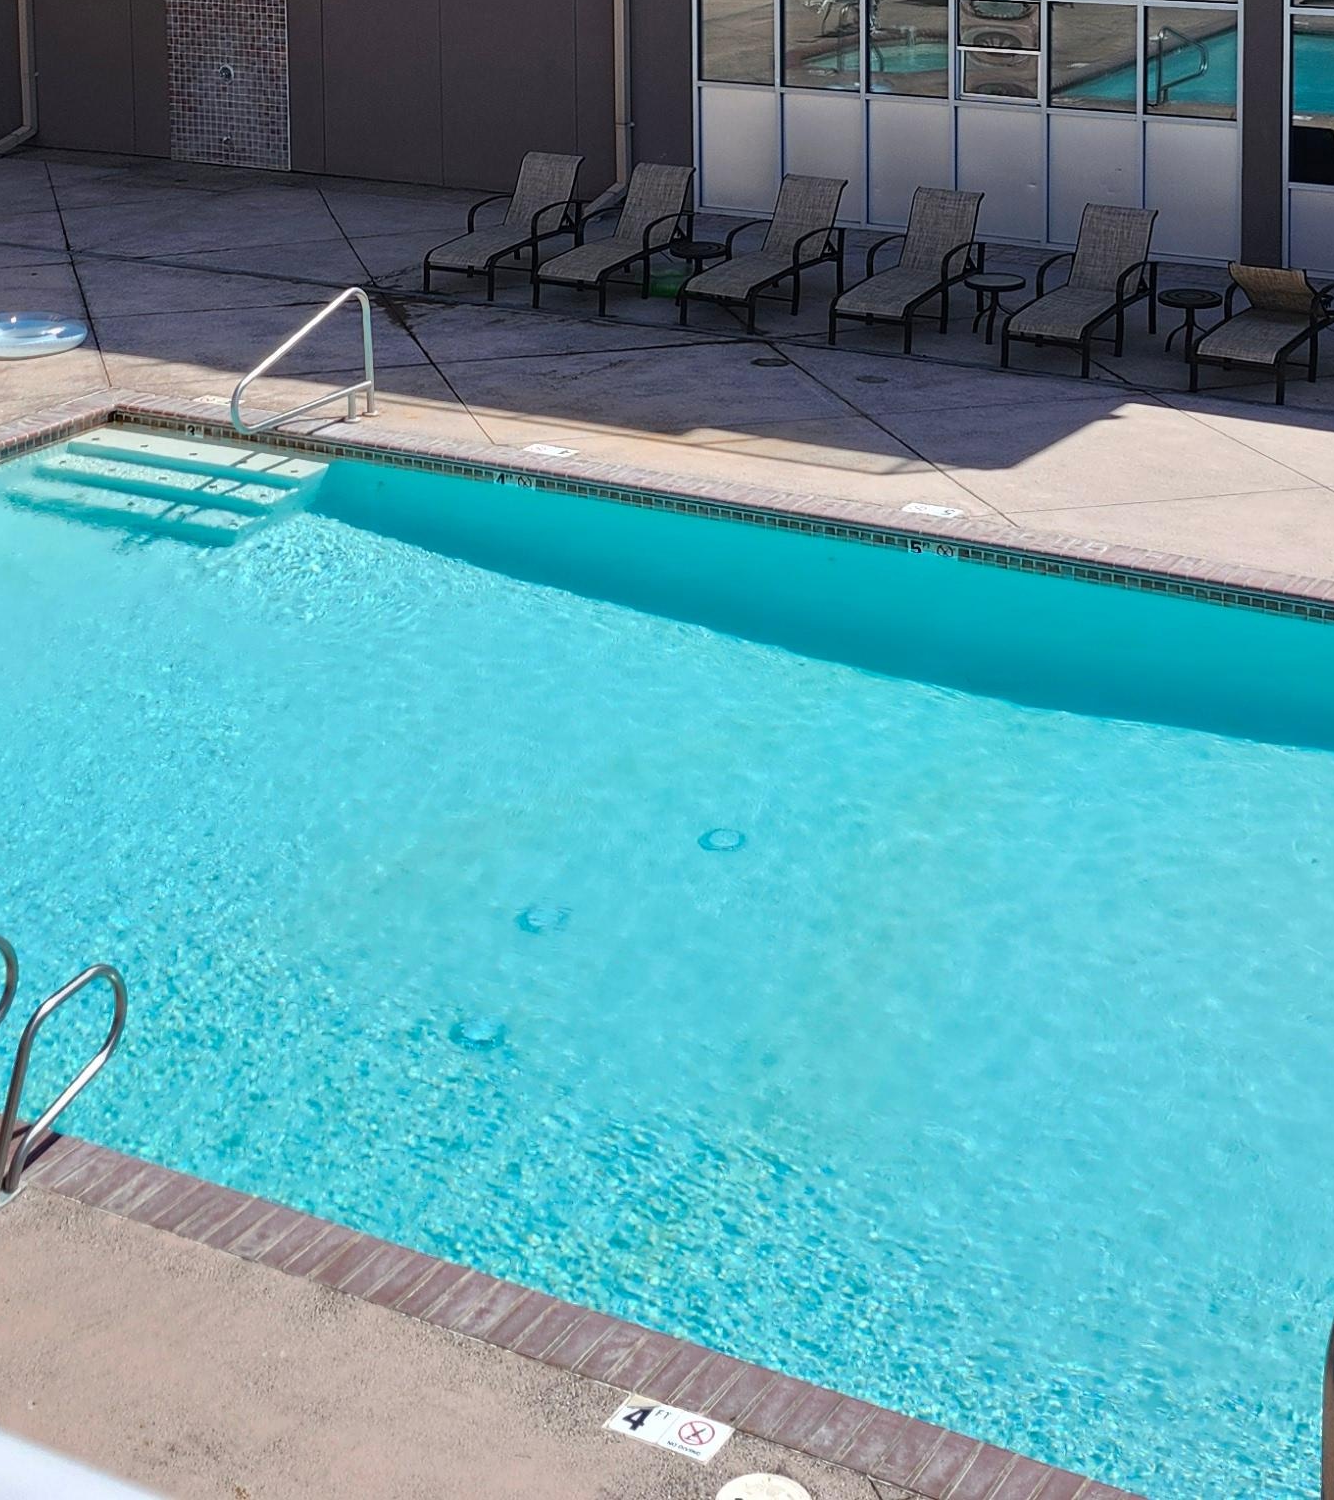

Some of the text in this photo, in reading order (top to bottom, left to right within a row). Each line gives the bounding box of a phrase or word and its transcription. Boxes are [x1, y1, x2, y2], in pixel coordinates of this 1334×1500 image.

[910, 540, 922, 554] 5
[622, 1406, 671, 1431] 4 FT
[678, 1444, 701, 1456] DIVING
